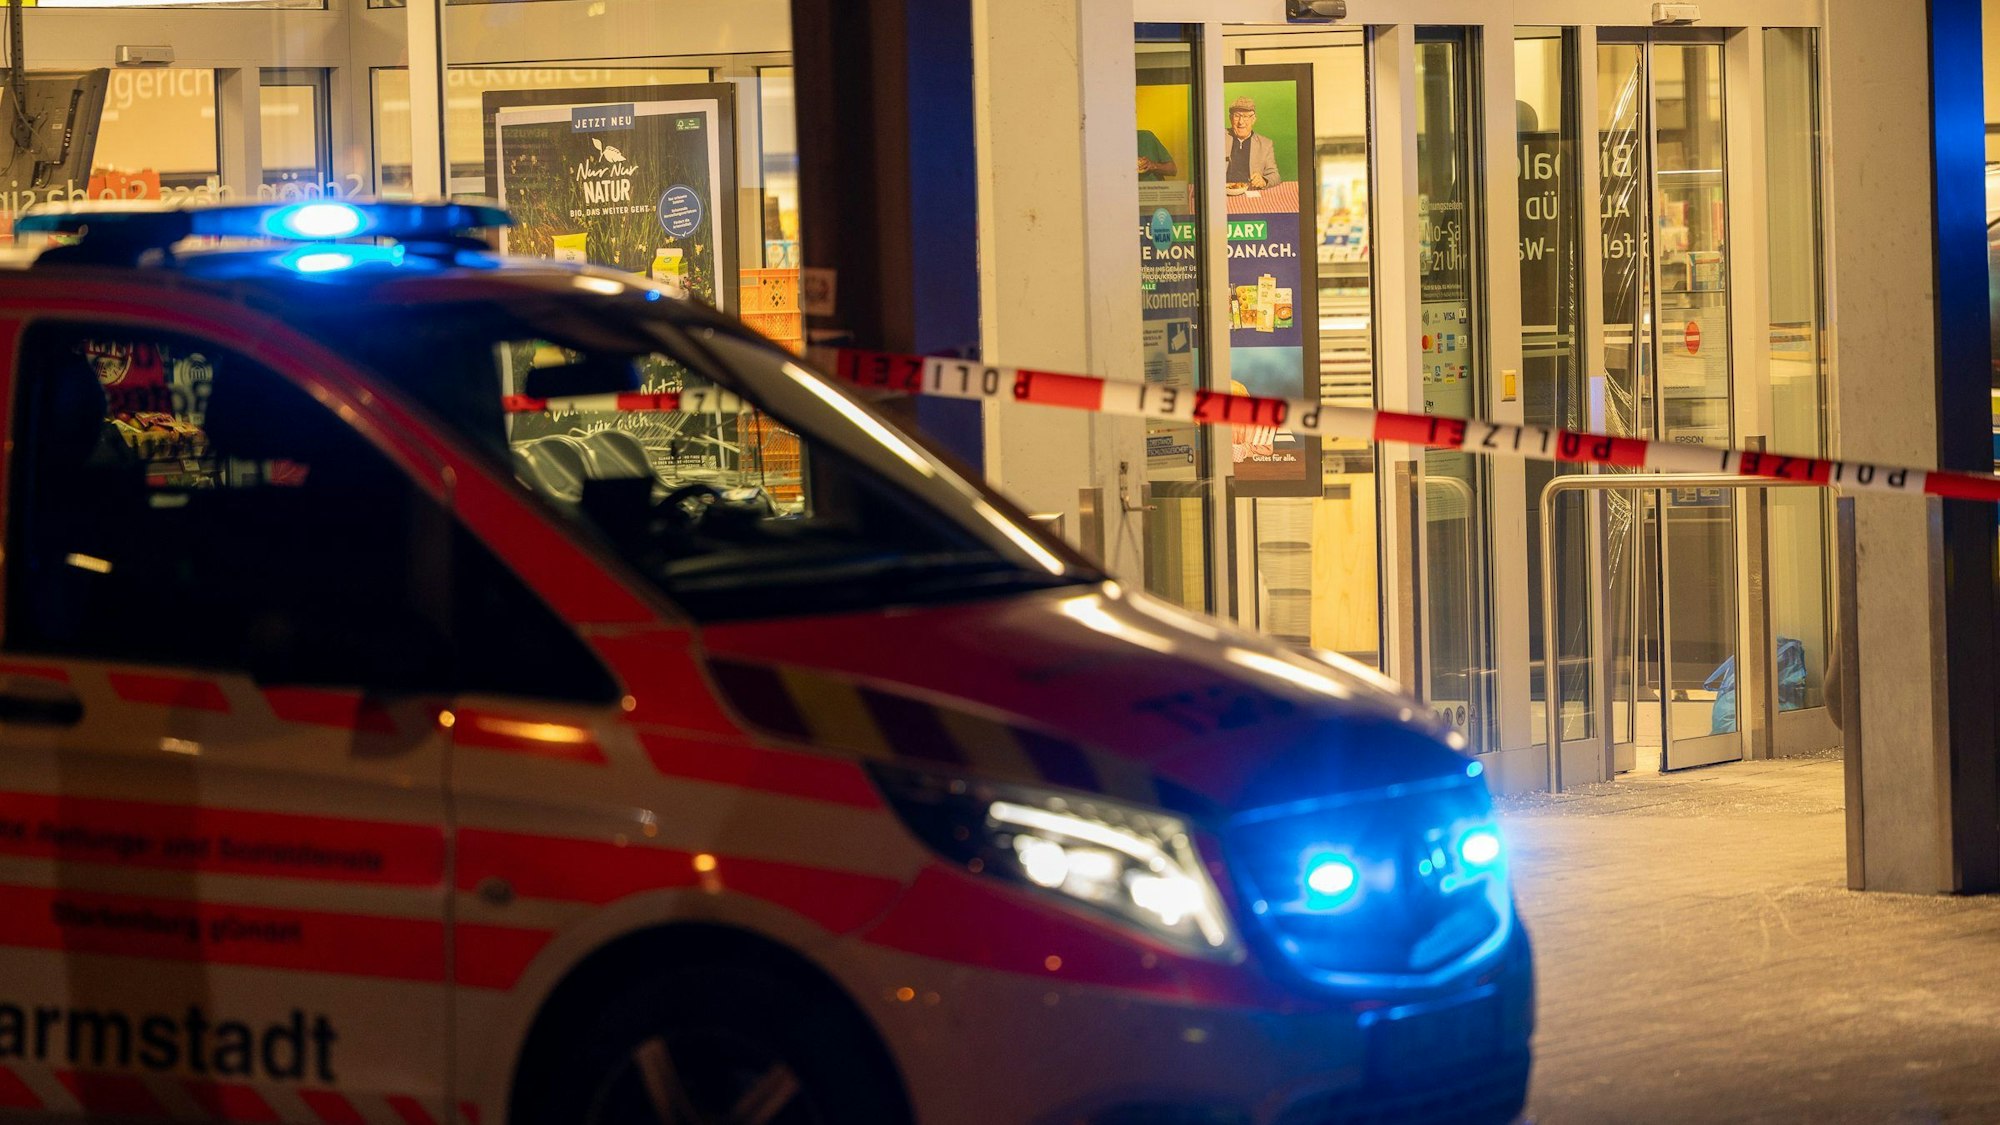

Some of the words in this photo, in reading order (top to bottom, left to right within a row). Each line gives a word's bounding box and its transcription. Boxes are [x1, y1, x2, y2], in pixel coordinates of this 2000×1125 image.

[449, 70, 612, 87] ackwaren
[574, 117, 606, 130] JETZT
[611, 115, 632, 127] NEU
[576, 159, 609, 182] Nur
[610, 162, 640, 178] Nur
[583, 178, 631, 204] NATUR
[586, 208, 601, 217] DAS
[602, 206, 629, 215] WEITER
[1154, 233, 1171, 243] WLAN
[1172, 224, 1196, 240] VE
[1156, 245, 1195, 260] MON
[1446, 248, 1468, 271] Uhr
[1142, 289, 1200, 309] lkommen!
[1443, 312, 1455, 321] VISA
[852, 353, 1030, 400] POLIZEI
[1139, 386, 1319, 429] POLIZEI
[1429, 418, 1612, 461] POLIZEI
[1675, 436, 1704, 444] EPSON
[1253, 454, 1272, 463] Gutes
[1273, 454, 1283, 462] für
[1284, 454, 1297, 462] alle.
[1720, 450, 1908, 488] POLIZEI
[0, 1000, 338, 1084] armstadt
